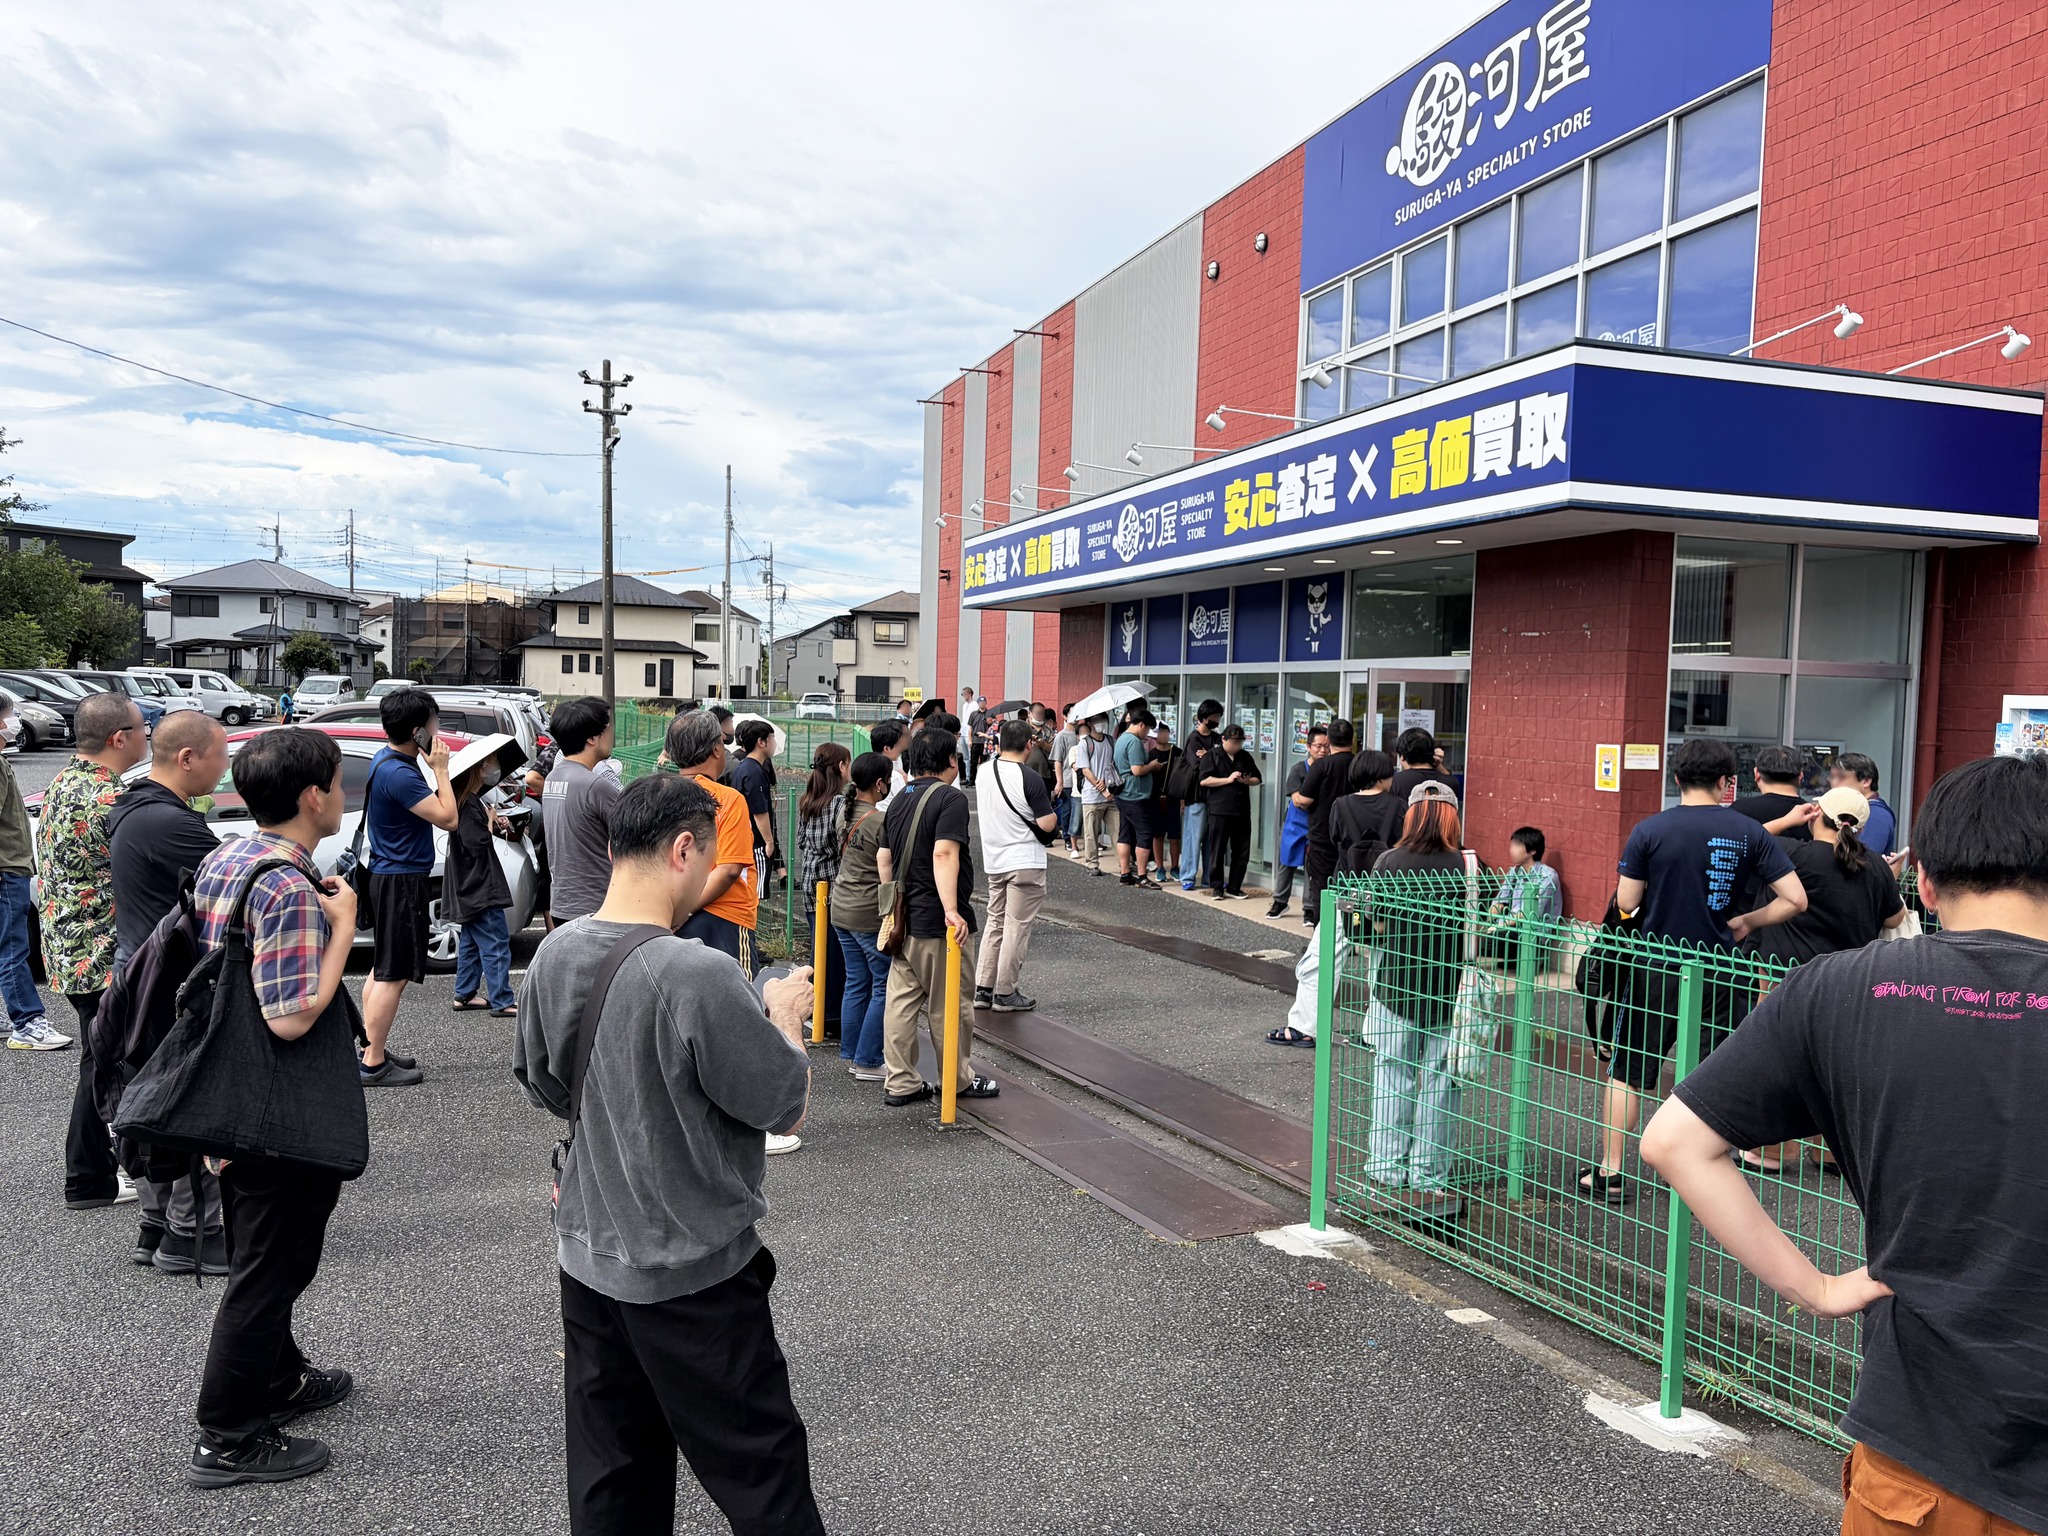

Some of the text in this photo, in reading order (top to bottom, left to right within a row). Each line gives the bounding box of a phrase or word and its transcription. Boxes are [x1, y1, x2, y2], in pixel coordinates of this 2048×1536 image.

[1385, 0, 1592, 187] 駿河屋
[1394, 106, 1592, 226] SURUGA-YA SPECIALTY STORE
[1223, 453, 1337, 535] 安心査定
[1390, 391, 1569, 500] 高価買取
[1181, 490, 1215, 509] SURUGA-YA
[1087, 519, 1113, 534] SURUGA-YA
[1112, 500, 1178, 562] 駿河屋
[1181, 508, 1213, 526] SPECIALTY
[1088, 534, 1111, 548] SPECIALTY
[1187, 526, 1206, 540] STORE
[964, 545, 1007, 590] 安心査定
[1025, 526, 1080, 577] 高価買取
[1092, 549, 1107, 561] STORE
[1189, 605, 1229, 639] 駿河屋
[1872, 980, 1937, 1002] STANDING
[1996, 992, 2021, 1008] FOR
